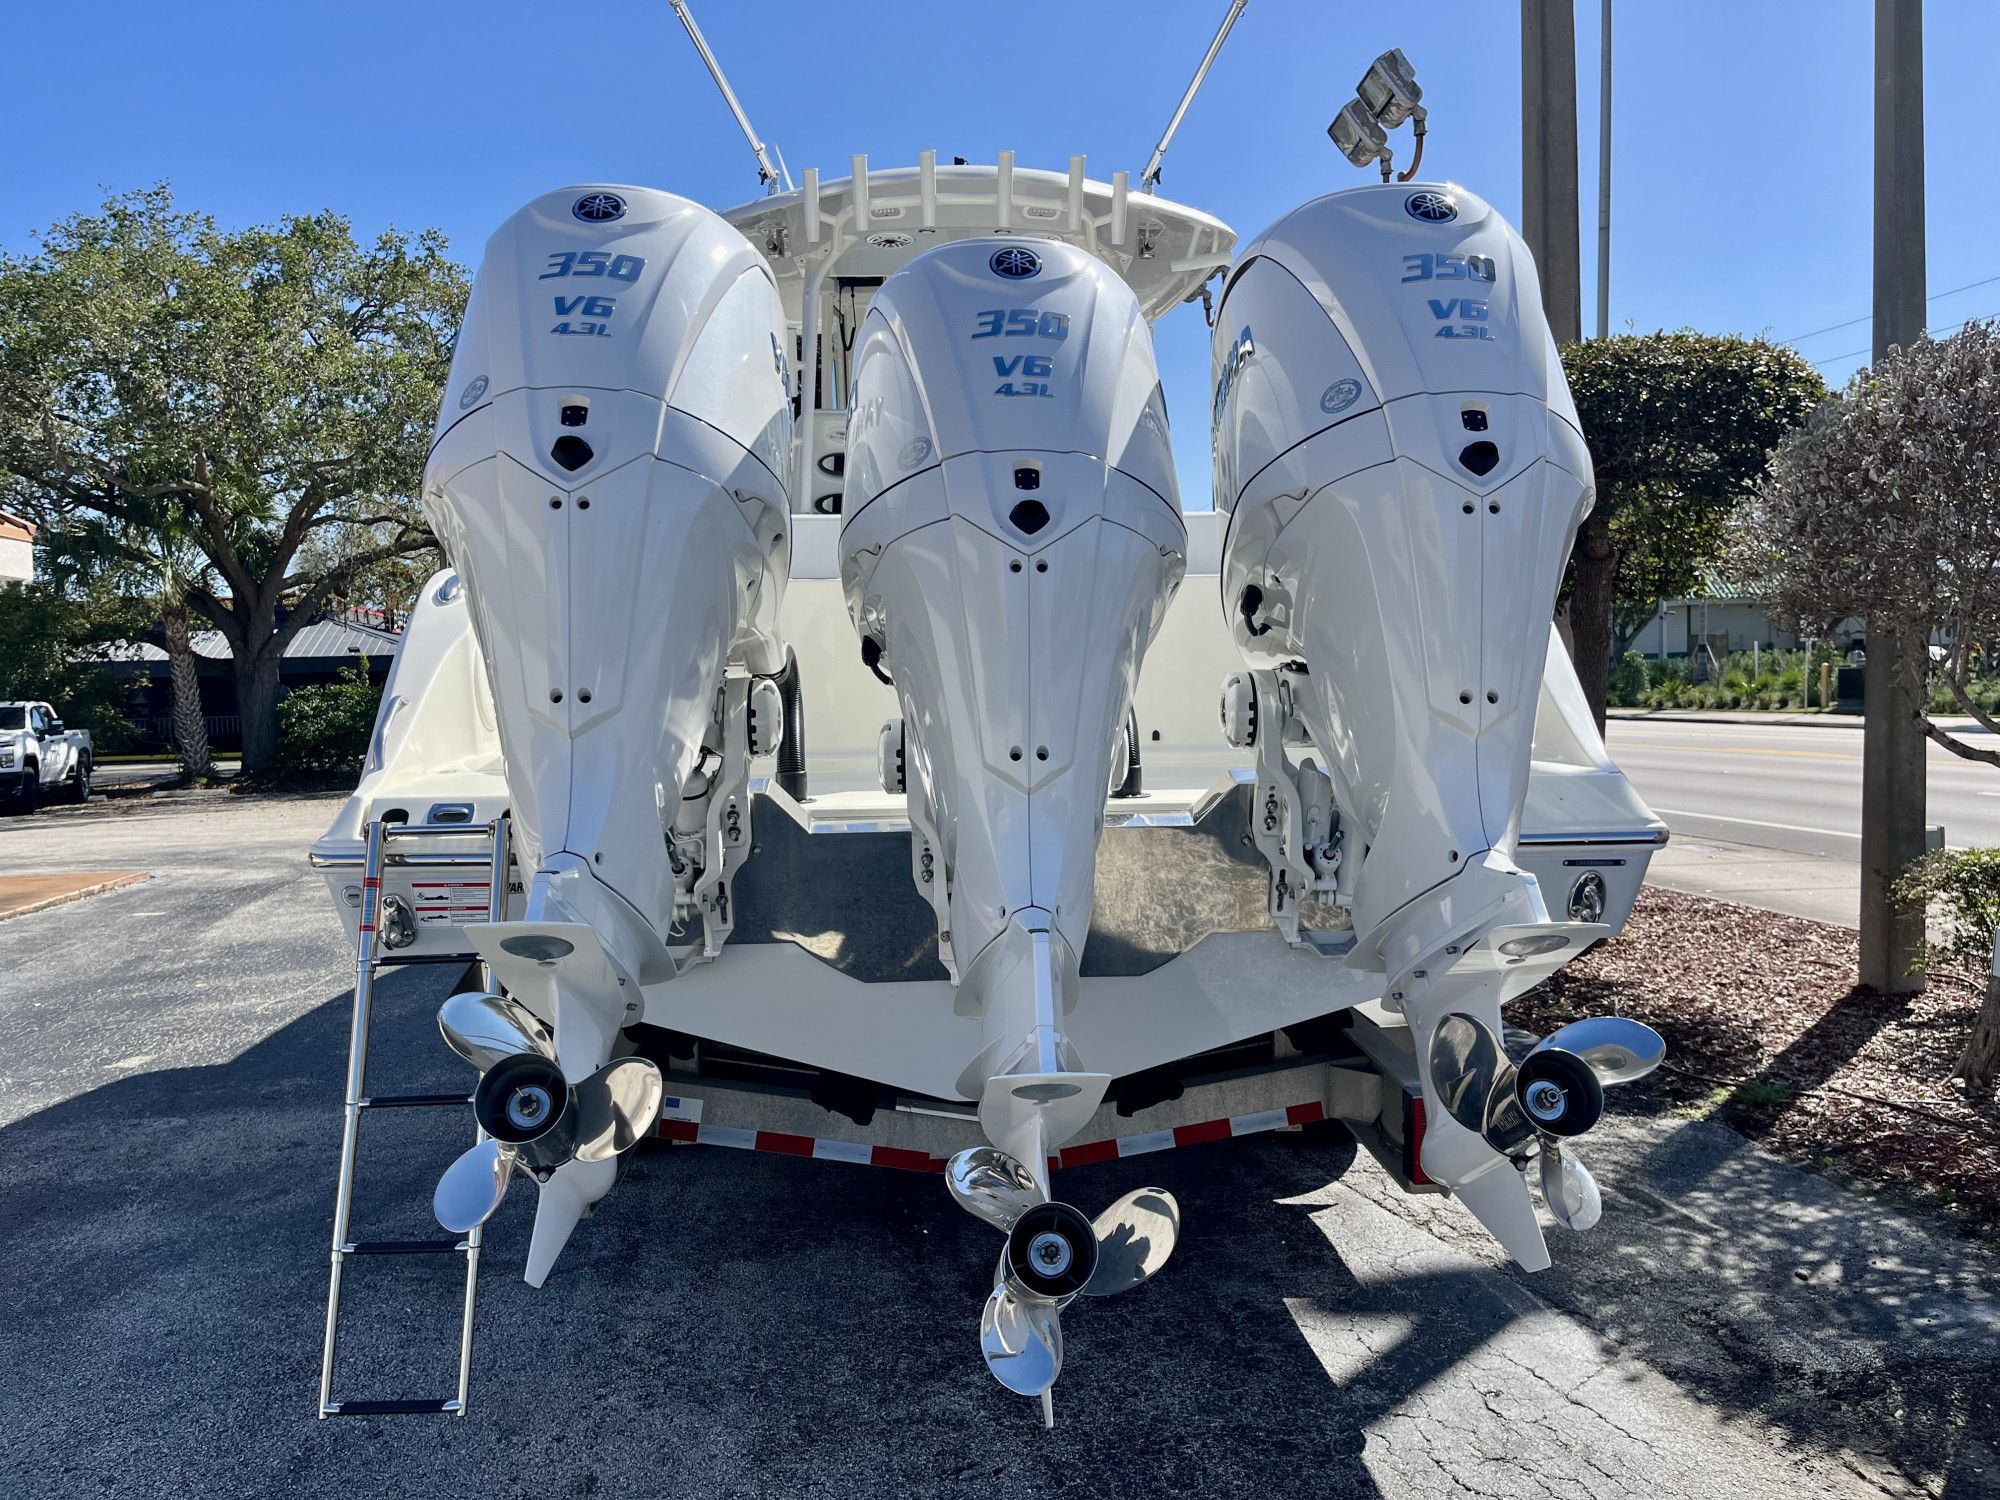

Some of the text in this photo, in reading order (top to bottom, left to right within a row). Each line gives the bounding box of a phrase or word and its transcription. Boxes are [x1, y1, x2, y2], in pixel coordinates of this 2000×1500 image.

[538, 251, 647, 283] 350
[1401, 253, 1496, 283] 350
[554, 296, 617, 318] V6
[1427, 298, 1488, 321] V6
[550, 322, 613, 337] 4.3L
[971, 309, 1070, 341] 350
[1434, 325, 1495, 341] 4.3L
[992, 355, 1053, 378] V6
[994, 382, 1055, 399] 4.3L
